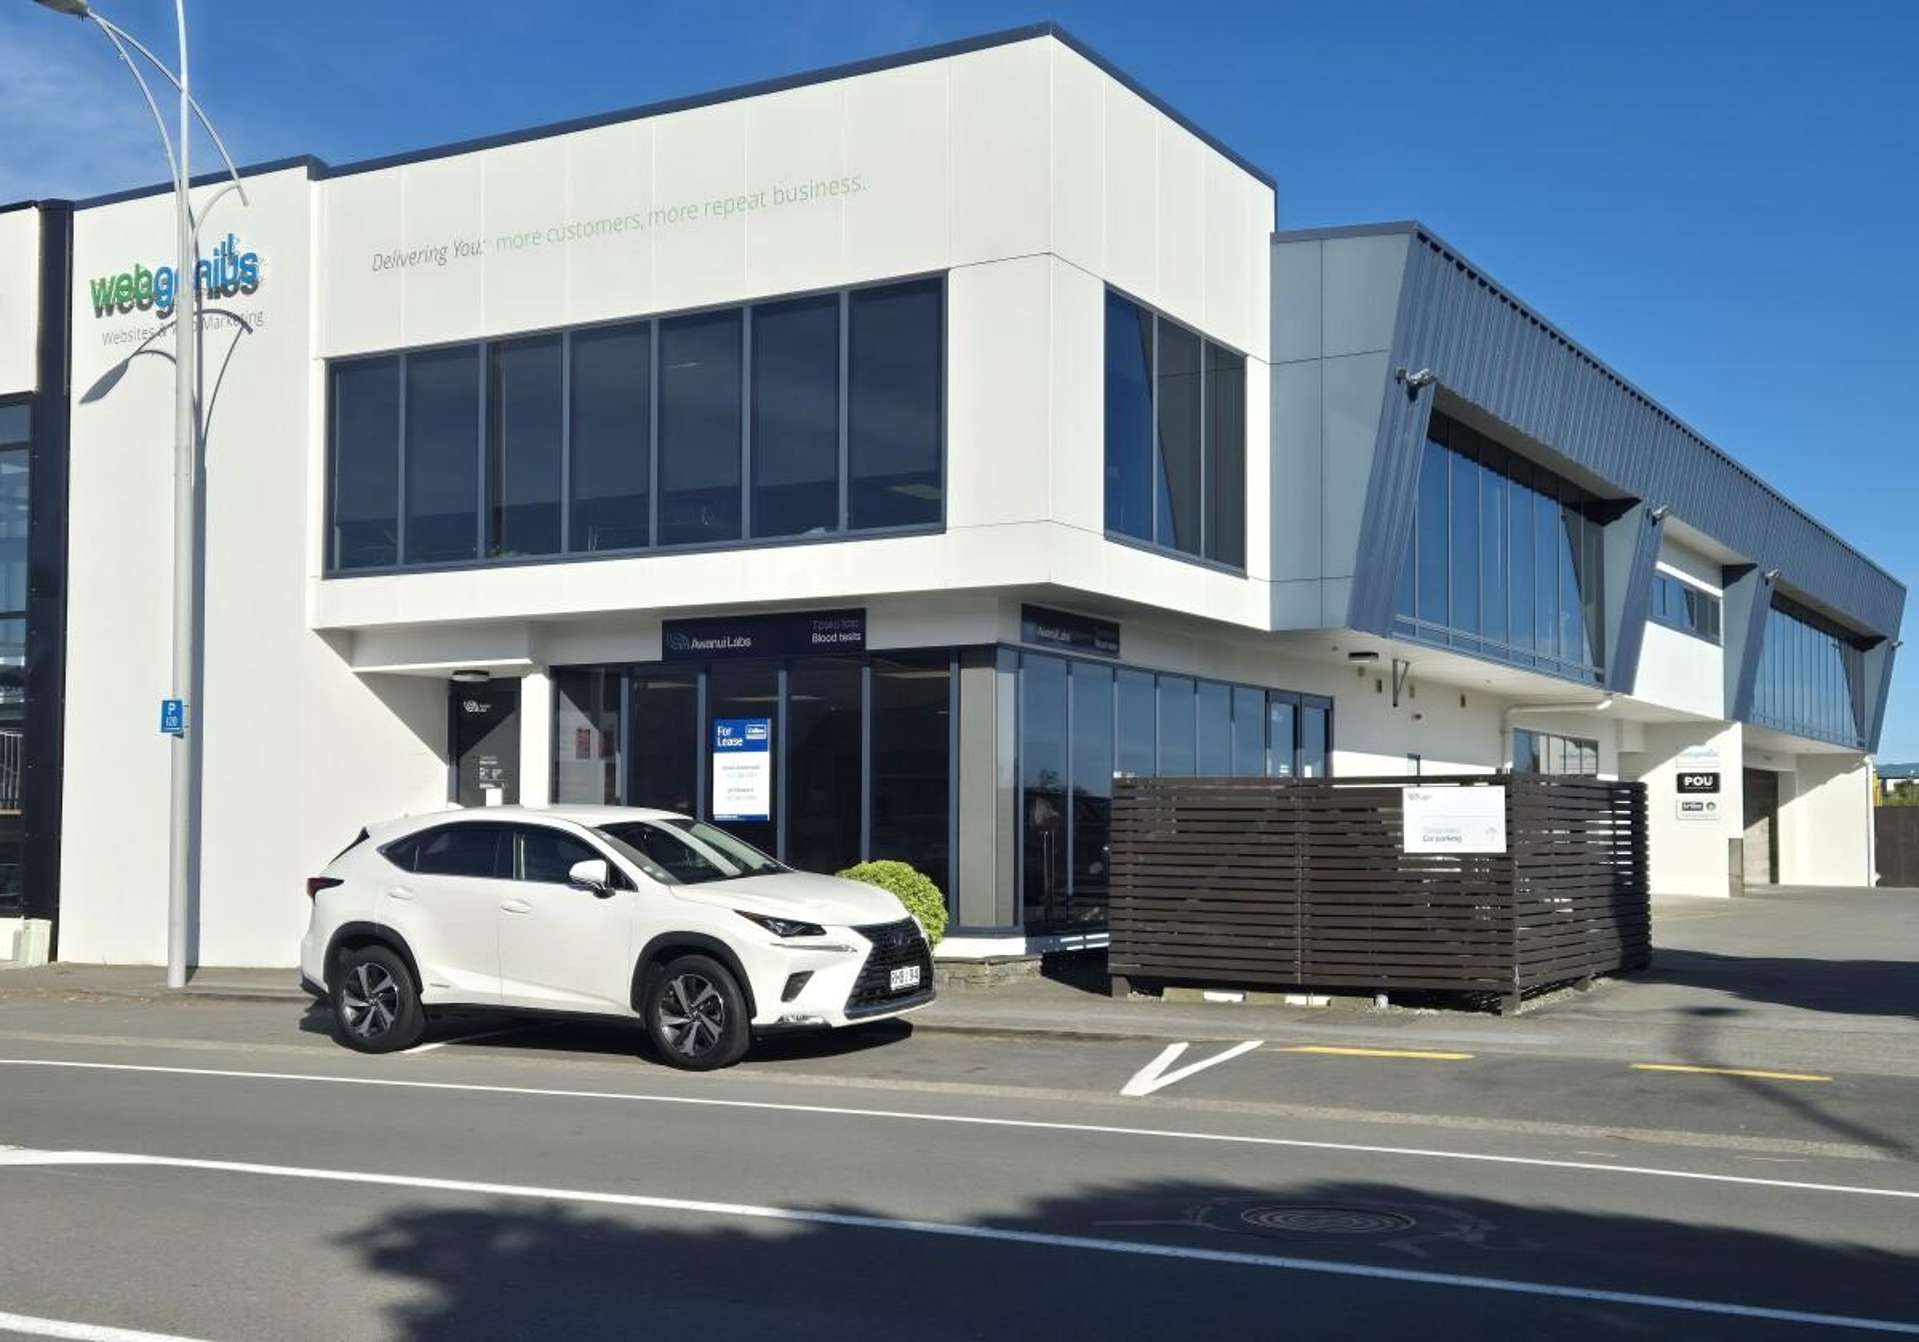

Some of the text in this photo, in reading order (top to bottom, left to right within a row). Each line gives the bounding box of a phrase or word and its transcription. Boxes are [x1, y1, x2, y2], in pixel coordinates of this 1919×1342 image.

[372, 244, 448, 272] Delivering
[496, 231, 541, 252] more
[546, 214, 644, 244] customers,
[648, 204, 699, 226] more
[704, 191, 767, 219] repeat
[772, 176, 868, 205] business.
[89, 234, 259, 317] webgnius
[102, 325, 154, 346] Websites
[812, 632, 837, 643] Blood
[168, 703, 177, 715] P
[717, 726, 735, 737] For
[717, 738, 743, 747] Lease
[1684, 776, 1713, 786] POU
